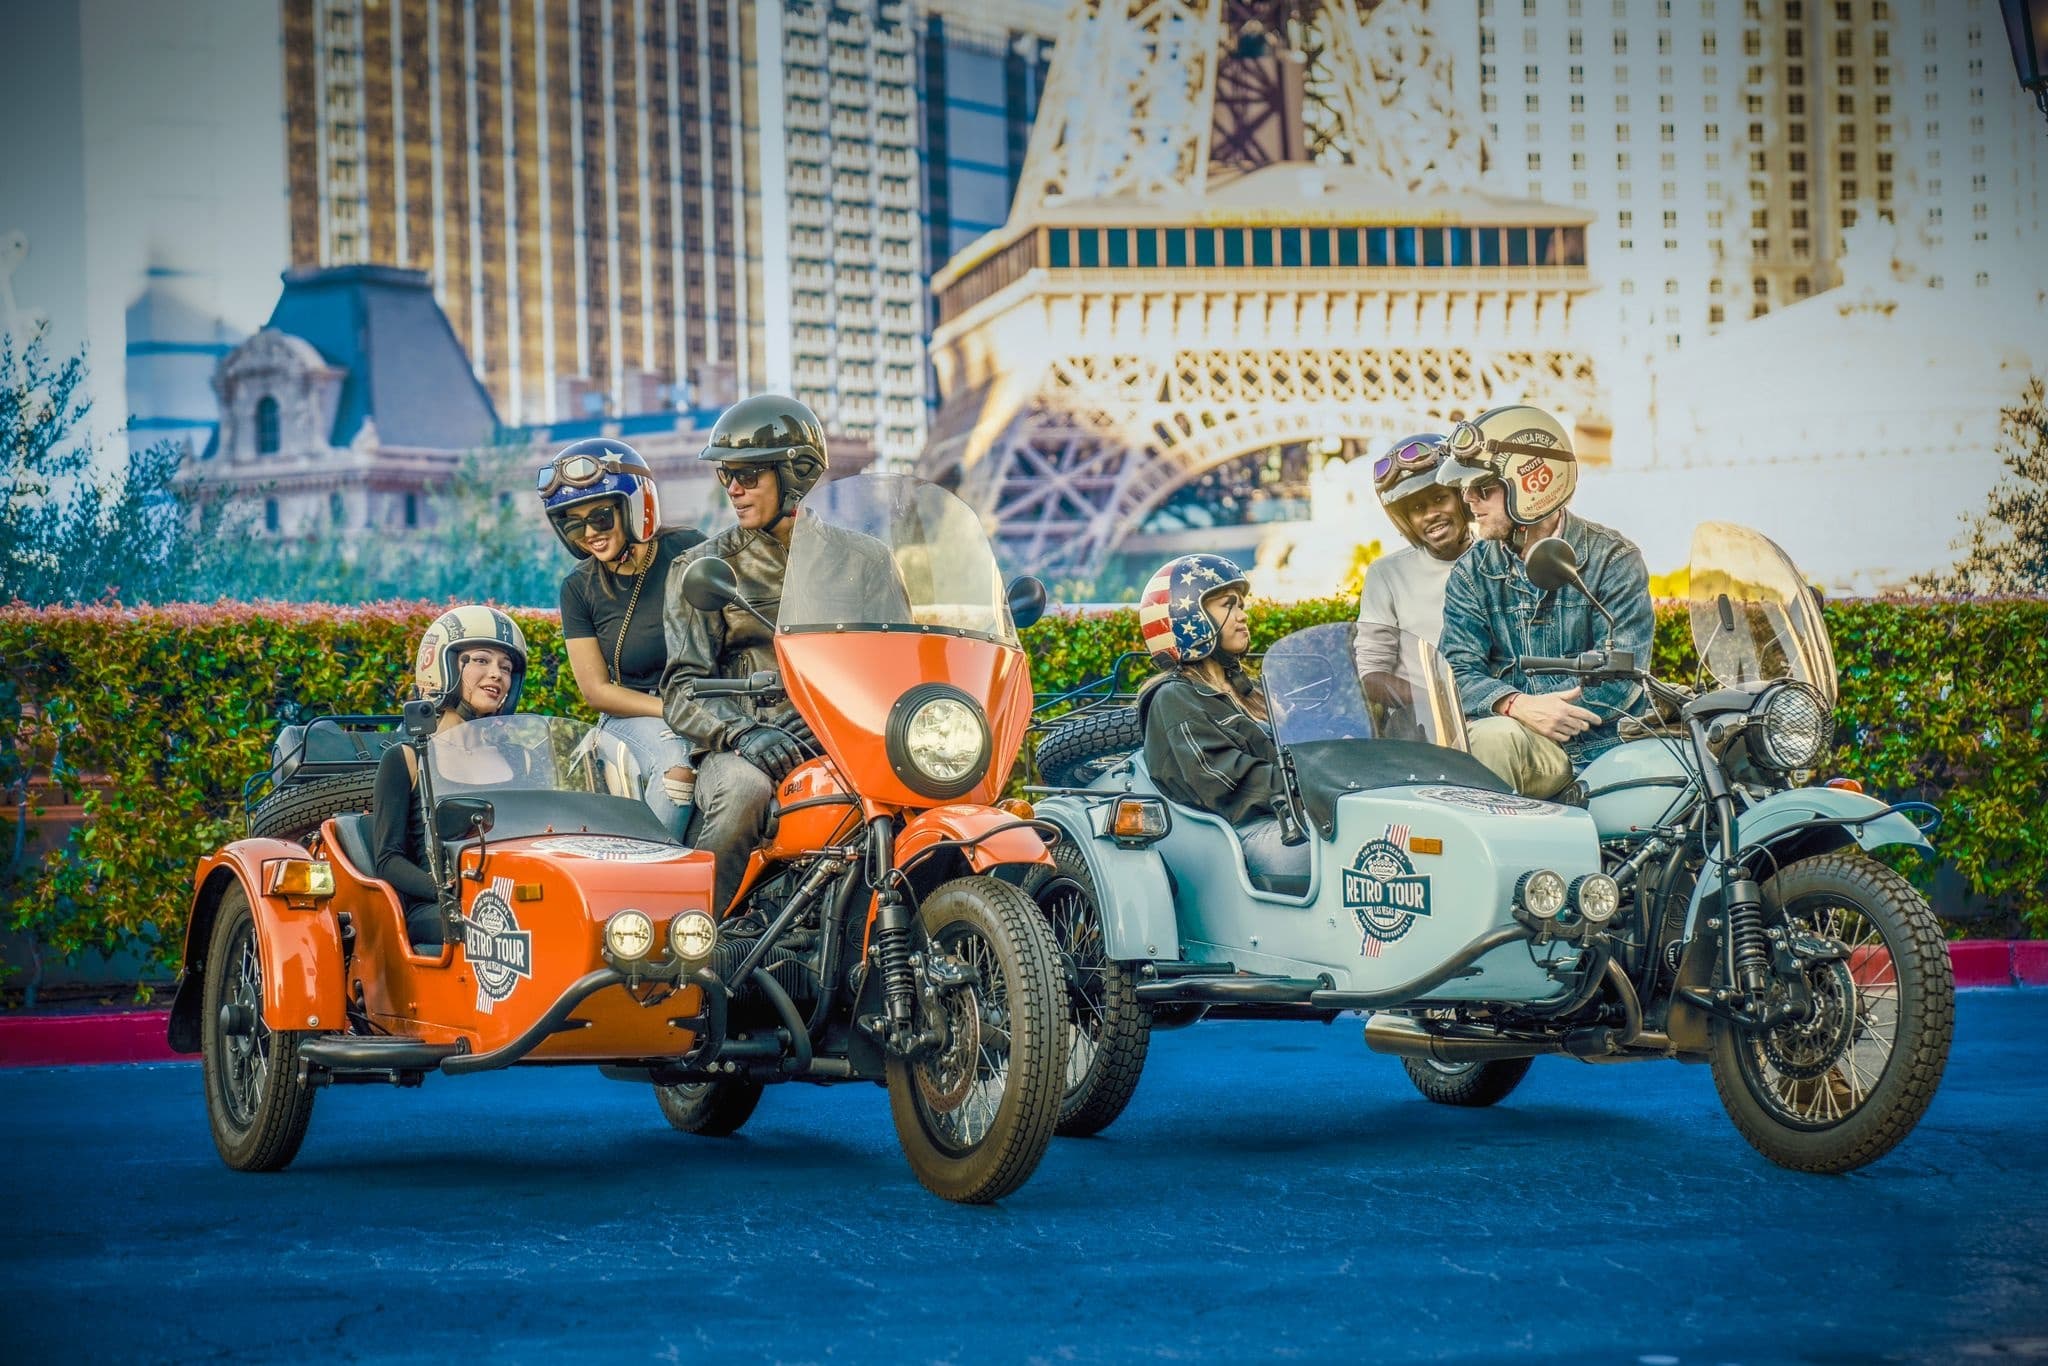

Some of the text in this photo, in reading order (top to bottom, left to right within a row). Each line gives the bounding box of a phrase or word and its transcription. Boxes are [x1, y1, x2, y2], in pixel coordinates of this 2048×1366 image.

[1535, 433, 1550, 447] PIER
[1520, 456, 1543, 475] ROUTE
[1527, 468, 1549, 491] 66
[784, 781, 803, 797] URAL
[1346, 874, 1425, 909] RETRO TOUR
[466, 926, 525, 967] RETRO TOUR
